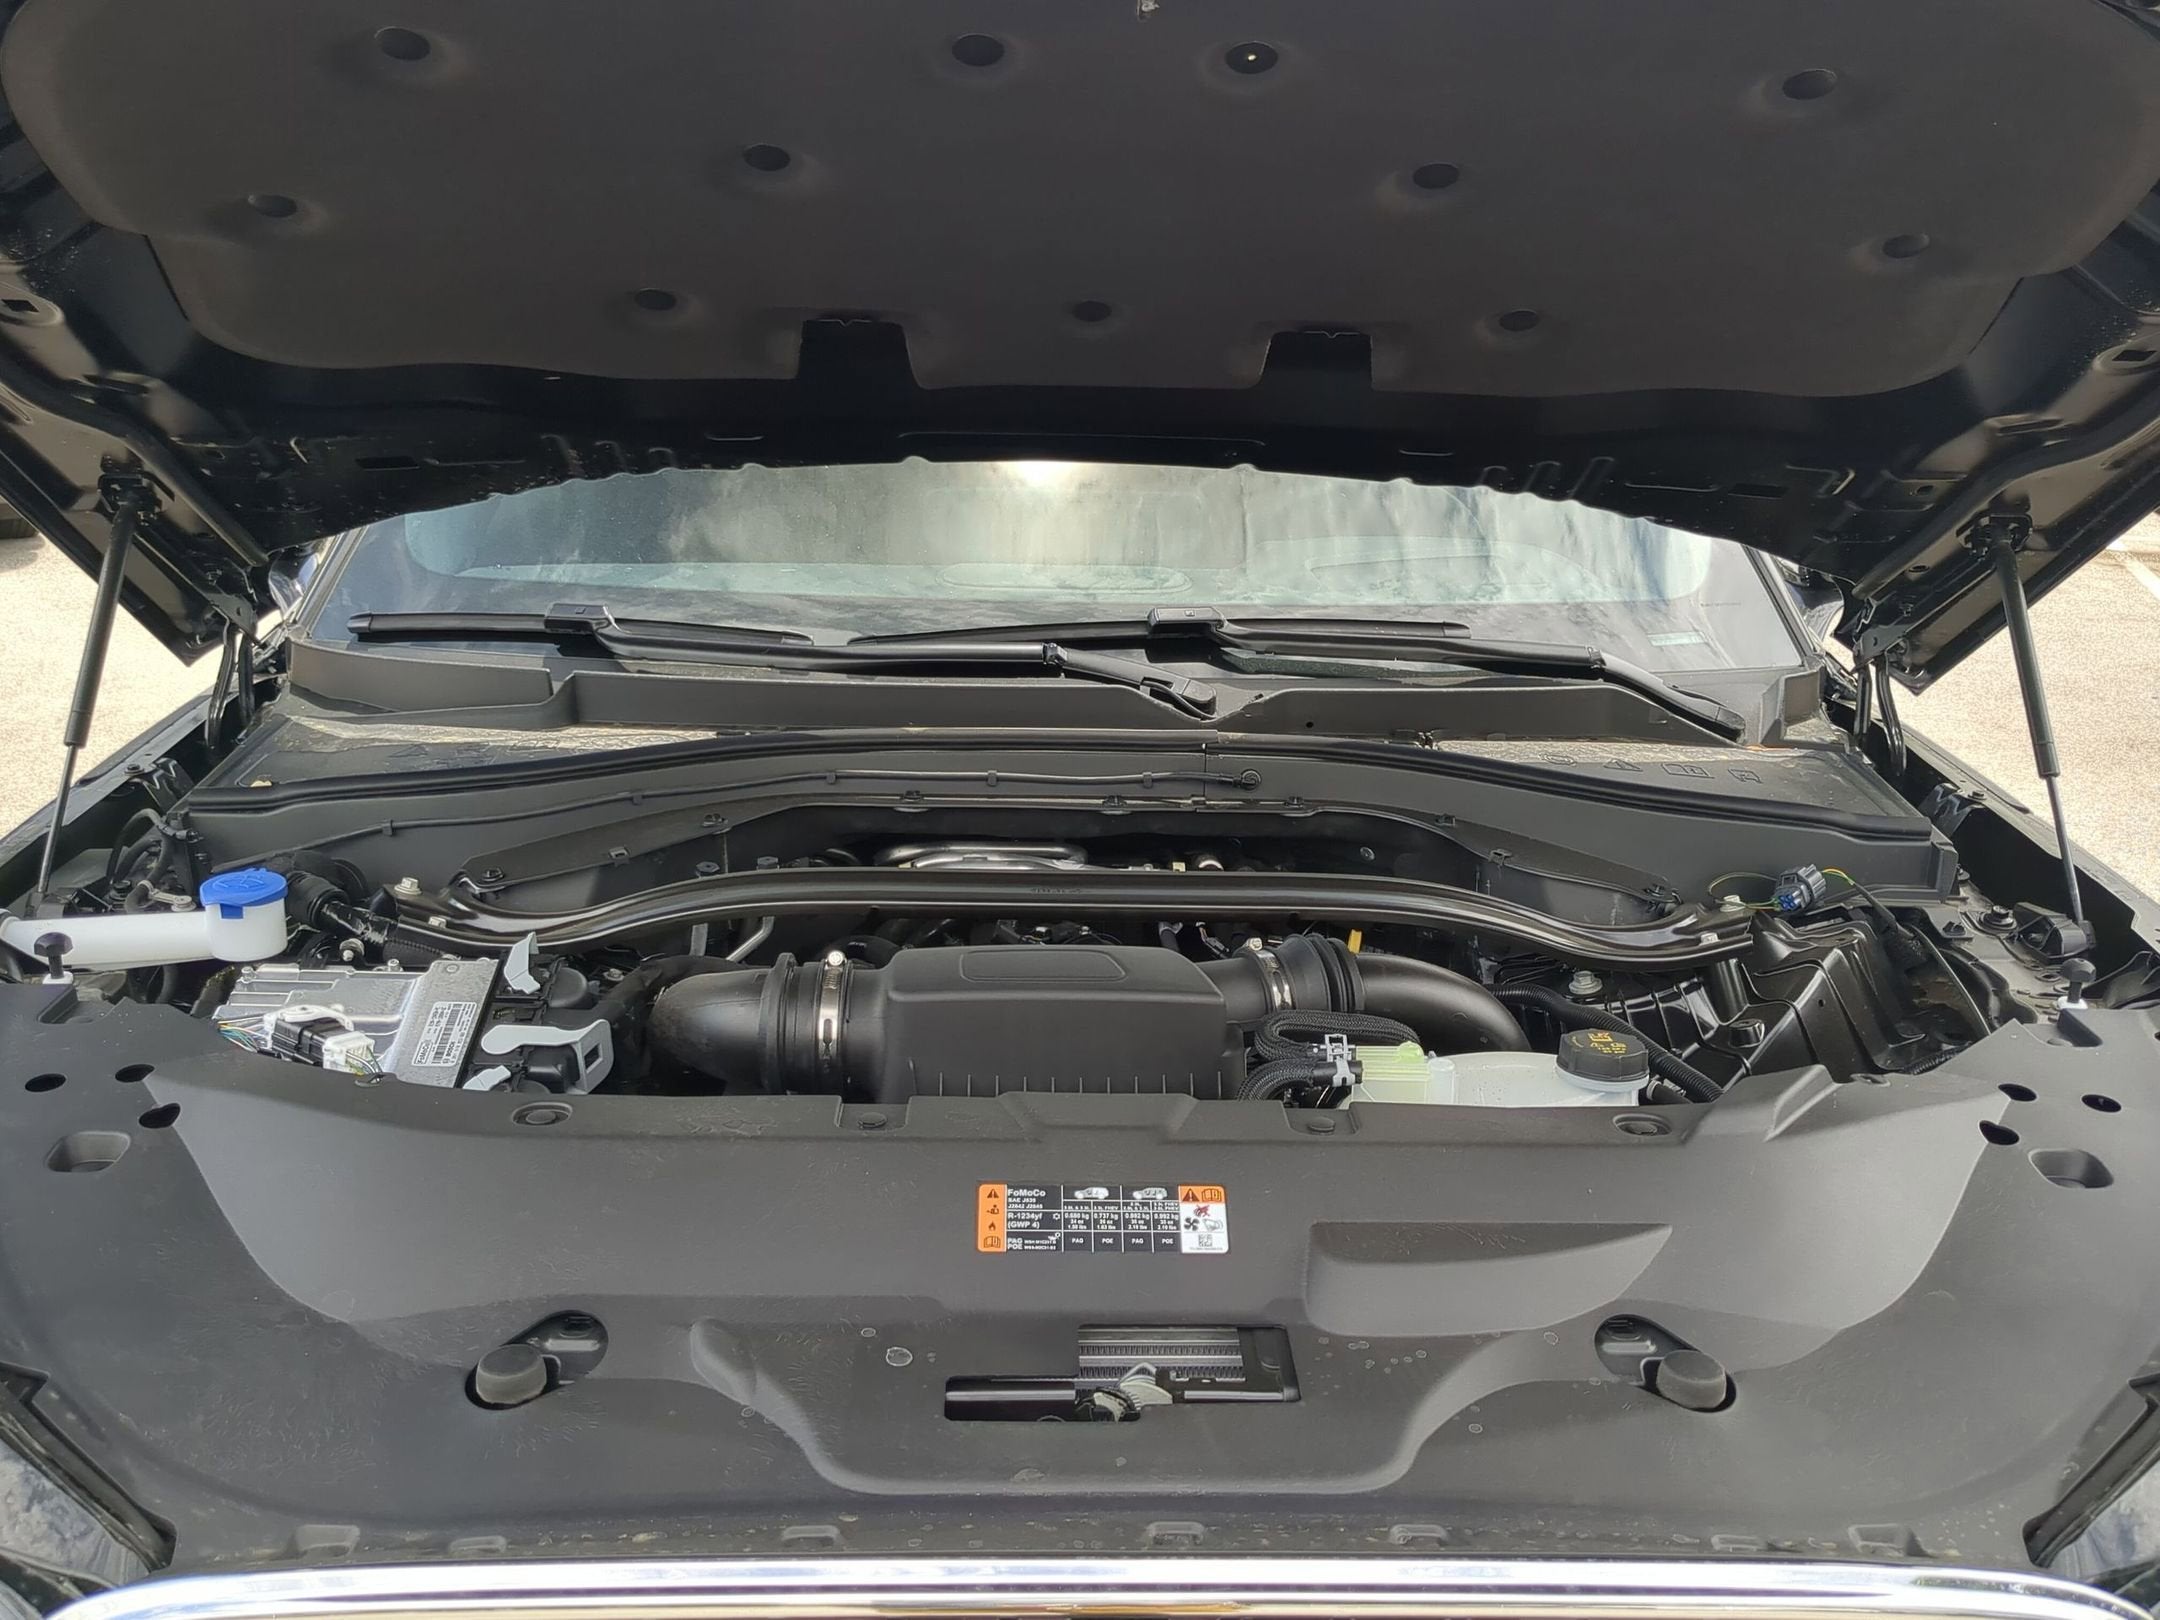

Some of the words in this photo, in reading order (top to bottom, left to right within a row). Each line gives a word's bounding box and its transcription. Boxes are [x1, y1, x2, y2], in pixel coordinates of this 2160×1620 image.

[445, 1042, 455, 1056] BOSCH
[1008, 1188, 1046, 1197] FoMoCo
[1008, 1212, 1043, 1221] R-1234yf
[1008, 1221, 1030, 1229] (GWP
[1032, 1221, 1040, 1229] 4)
